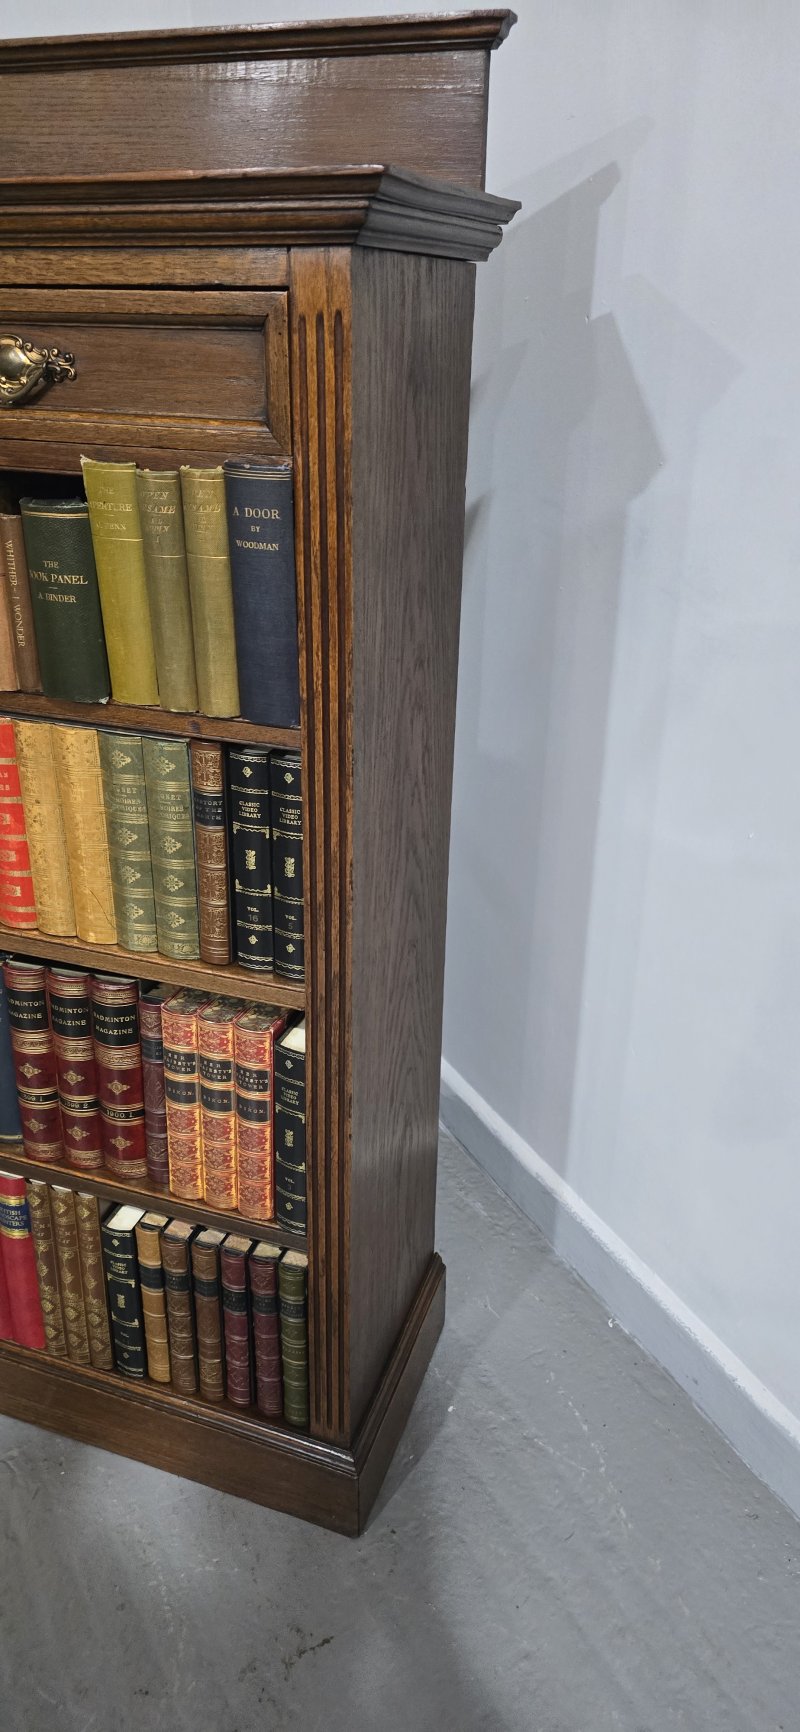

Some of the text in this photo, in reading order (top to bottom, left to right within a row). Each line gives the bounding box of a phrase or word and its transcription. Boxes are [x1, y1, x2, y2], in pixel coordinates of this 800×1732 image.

[143, 504, 176, 514] SAME
[233, 506, 281, 520] A DOOR
[251, 525, 261, 533] BY
[236, 540, 280, 551] WOODMAN
[43, 560, 59, 569] THE
[50, 573, 89, 585] PANEL
[5, 540, 18, 587] WHITHER
[12, 604, 26, 648] WONDER
[45, 592, 77, 603] BINDER
[238, 811, 262, 819] LIBRARY
[280, 807, 301, 815] CLASSIC
[280, 818, 302, 826] LIBRARY
[248, 914, 259, 922] 16
[8, 998, 45, 1007] DMINTON
[164, 1056, 196, 1066] AJESTY'S
[200, 1063, 231, 1074] AJESTY'S
[236, 1072, 268, 1084] AJESTY'S
